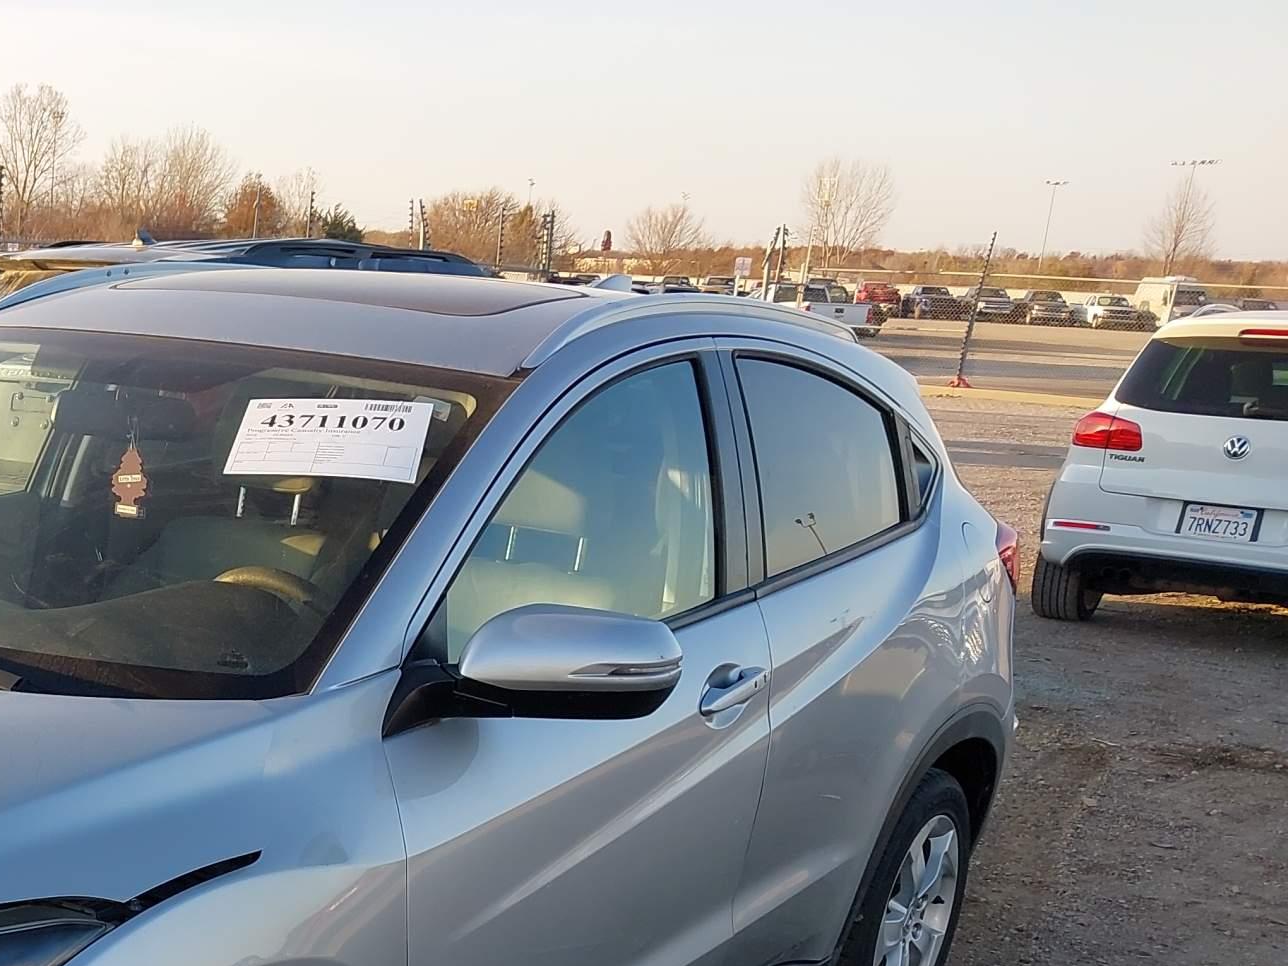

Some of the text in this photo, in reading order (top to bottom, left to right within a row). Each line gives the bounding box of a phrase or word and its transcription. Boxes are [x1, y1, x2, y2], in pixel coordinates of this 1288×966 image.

[260, 414, 405, 432] 43711070
[1109, 453, 1145, 463] TIGUAN
[1187, 516, 1249, 537] 7RNZ733
